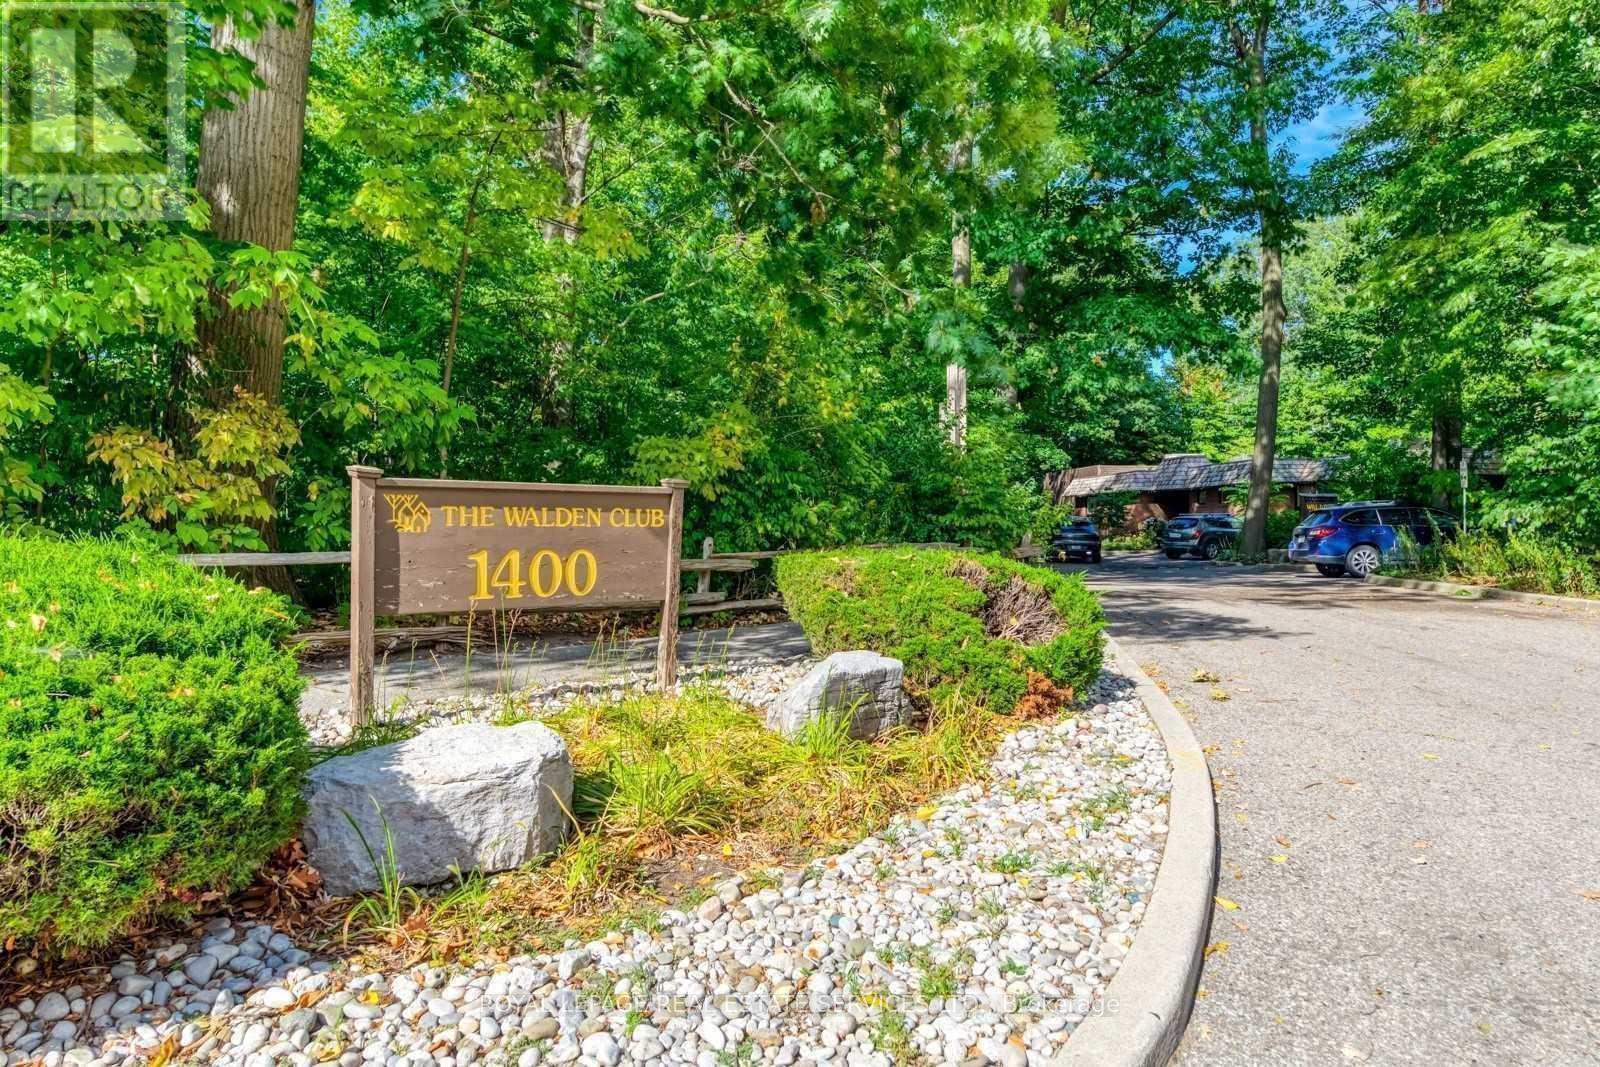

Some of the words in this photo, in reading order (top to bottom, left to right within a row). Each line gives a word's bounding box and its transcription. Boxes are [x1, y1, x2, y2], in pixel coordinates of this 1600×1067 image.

[440, 505, 496, 528] THE
[503, 506, 602, 528] WALDEN
[608, 507, 665, 528] CLUB
[467, 548, 598, 600] 1400
